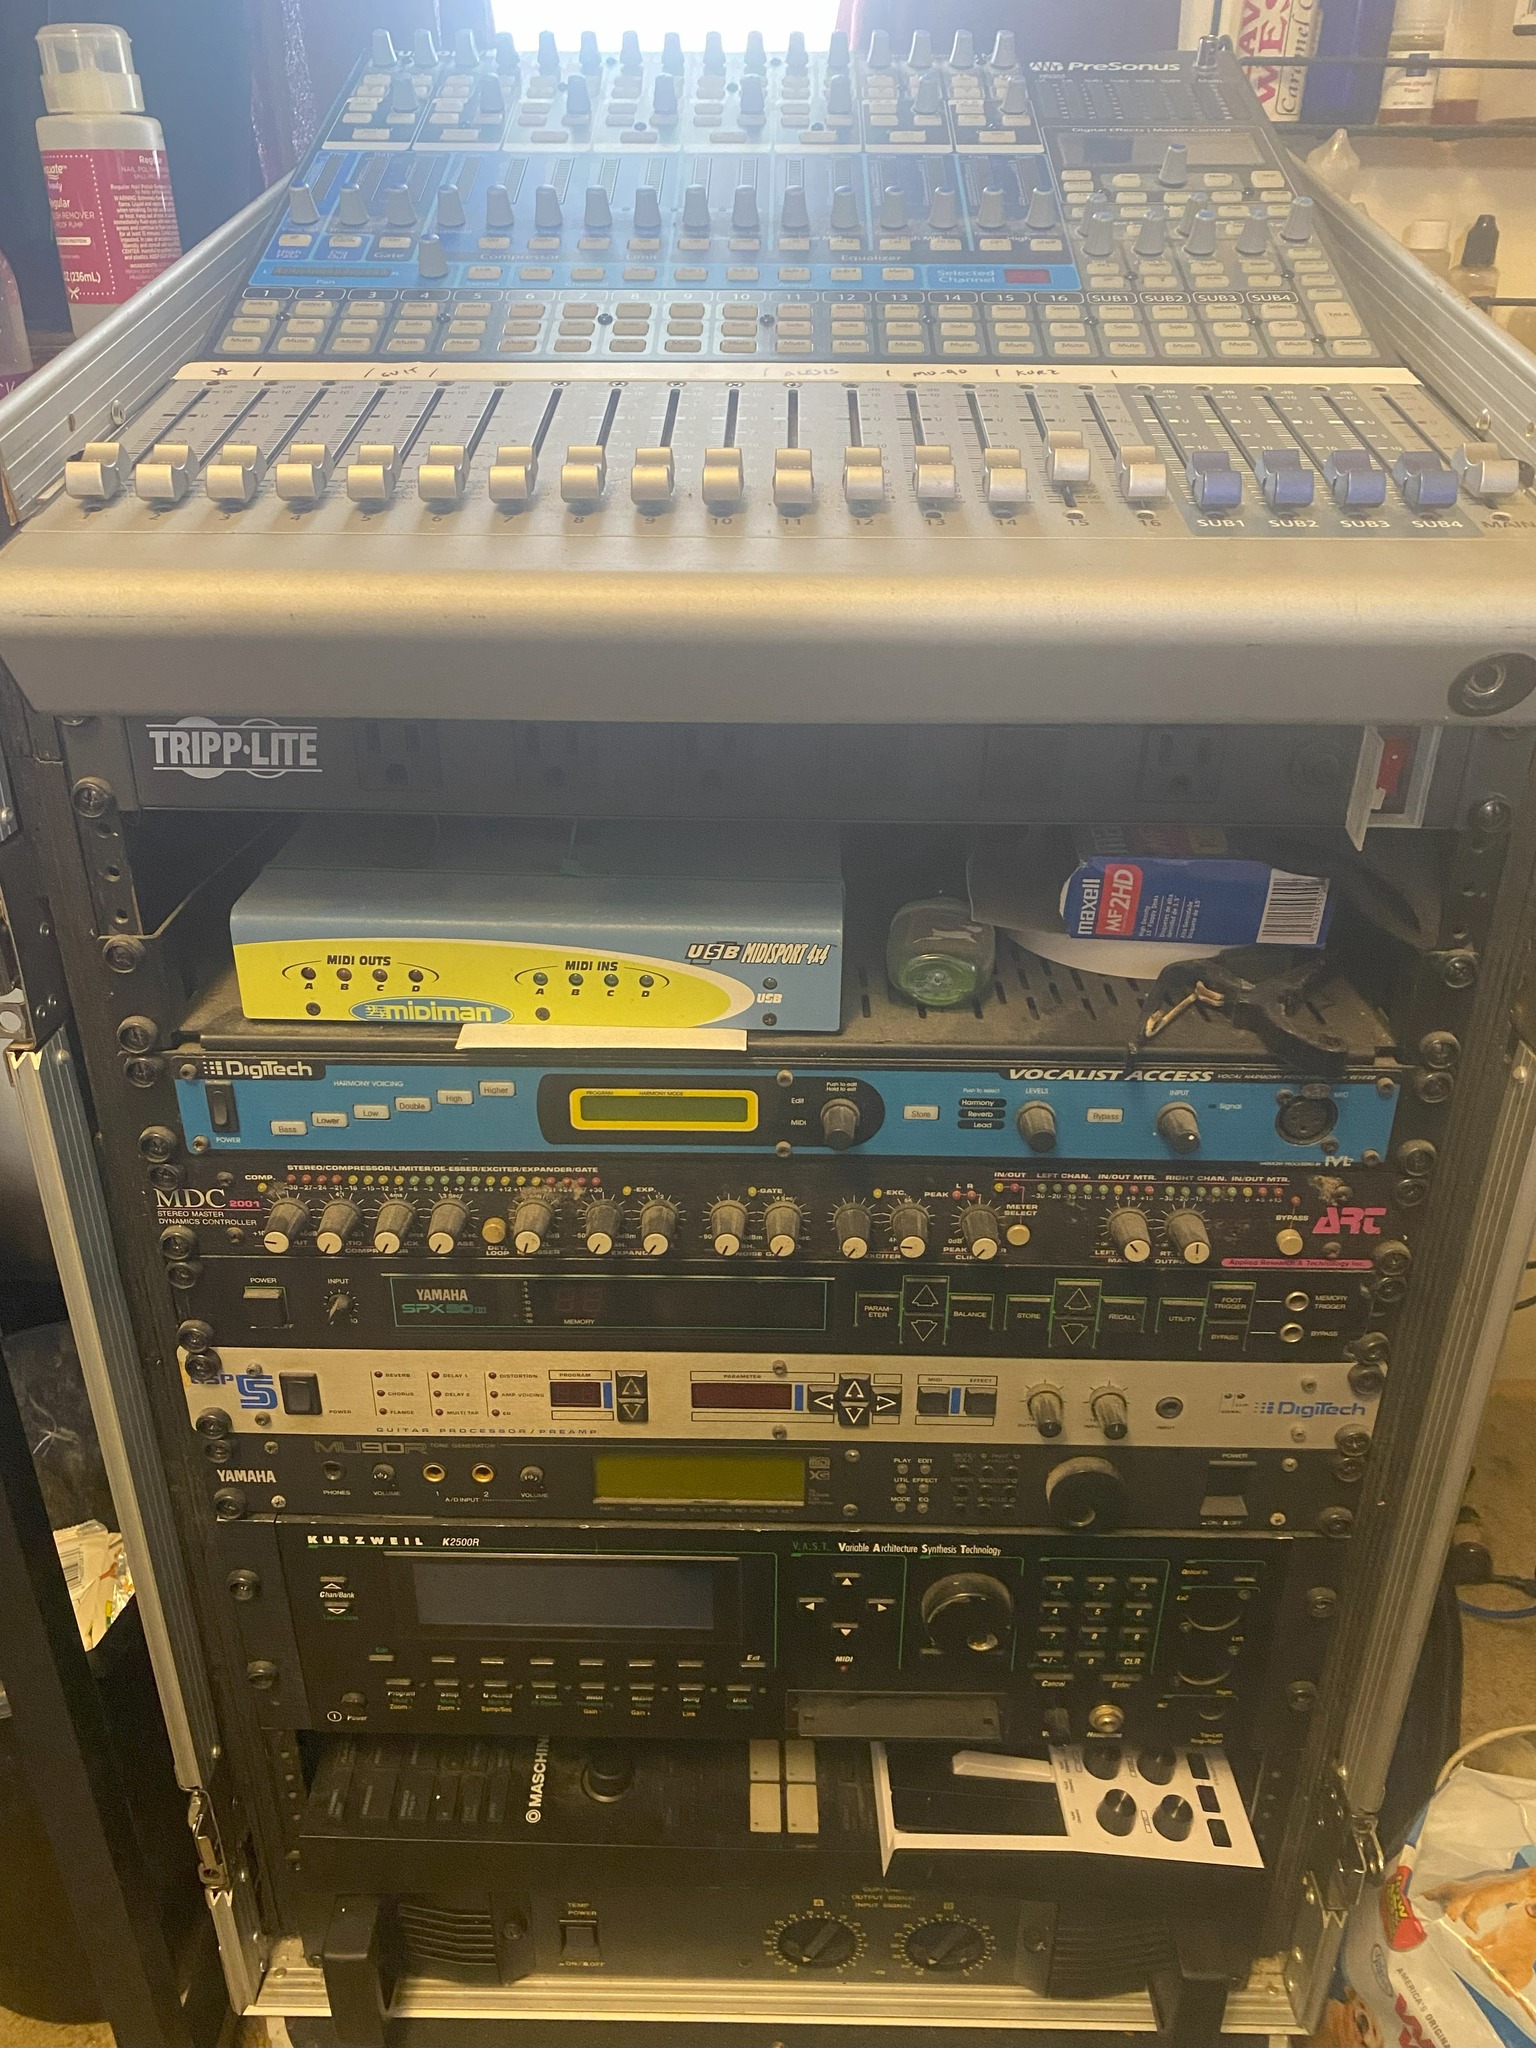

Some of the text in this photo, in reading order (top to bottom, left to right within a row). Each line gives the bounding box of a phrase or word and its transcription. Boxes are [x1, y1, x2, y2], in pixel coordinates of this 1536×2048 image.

[1068, 61, 1181, 71] PreSonus
[480, 253, 561, 261] Compressor
[70, 271, 100, 283] (236mL)
[937, 269, 995, 277] Selected
[938, 276, 995, 284] Channel
[1050, 294, 1068, 302] 16
[1092, 294, 1129, 303] SUB1
[1145, 294, 1184, 303] SUB2
[1197, 293, 1237, 302] SUB3
[1251, 293, 1291, 302] SUB4
[1016, 369, 1061, 377] KURZ
[712, 517, 733, 525] 10
[782, 518, 801, 526] 11
[854, 519, 874, 527] 12
[925, 519, 946, 527] 13
[996, 519, 1017, 527] 14
[1068, 519, 1089, 527] 15
[1139, 519, 1161, 528] 16
[1197, 519, 1245, 527] SUB1
[1269, 520, 1319, 528] SUB2
[1340, 520, 1391, 528] SUB3
[1412, 520, 1463, 528] SUB4
[1482, 520, 1536, 529] MAIN
[1077, 878, 1101, 935] maxell
[685, 942, 832, 965] USB MIDISPORT 4x4
[327, 955, 391, 966] MIDI OUTS
[565, 961, 618, 971] MIDI INS
[571, 988, 580, 996] B
[641, 990, 650, 998] D
[757, 993, 782, 1004] USB
[226, 1061, 312, 1079] DigiTech
[1009, 1069, 1214, 1082] VOCALIST ACCESS
[372, 1080, 404, 1088] VOICING
[484, 1086, 509, 1096] Higher
[446, 1095, 463, 1104] High
[962, 1099, 995, 1107] Harmony
[399, 1102, 425, 1110] Double
[1219, 1103, 1242, 1111] Signal
[363, 1109, 379, 1117] Low
[911, 1110, 931, 1118] Store
[1092, 1112, 1119, 1121] Bypass
[316, 1116, 340, 1125] Lower
[278, 1125, 297, 1133] Bass
[154, 1189, 227, 1208] MDC
[229, 1200, 261, 1208] 2001
[1312, 1206, 1387, 1235] ART
[1228, 1259, 1259, 1267] Applied
[1260, 1259, 1297, 1267] Research
[1305, 1259, 1351, 1268] Technology
[416, 1289, 468, 1301] YAMAHA
[1278, 1402, 1365, 1418] DigiTech
[217, 1469, 276, 1483] YAMAHA
[307, 1535, 480, 1547] KURZWEIL K2500R
[838, 1543, 1001, 1556] Variable Architecture Synthesis Technology
[835, 1654, 853, 1662] MIDI
[528, 1736, 550, 1807] MASCHIN
[1397, 1967, 1427, 2013] AMERICA'S
